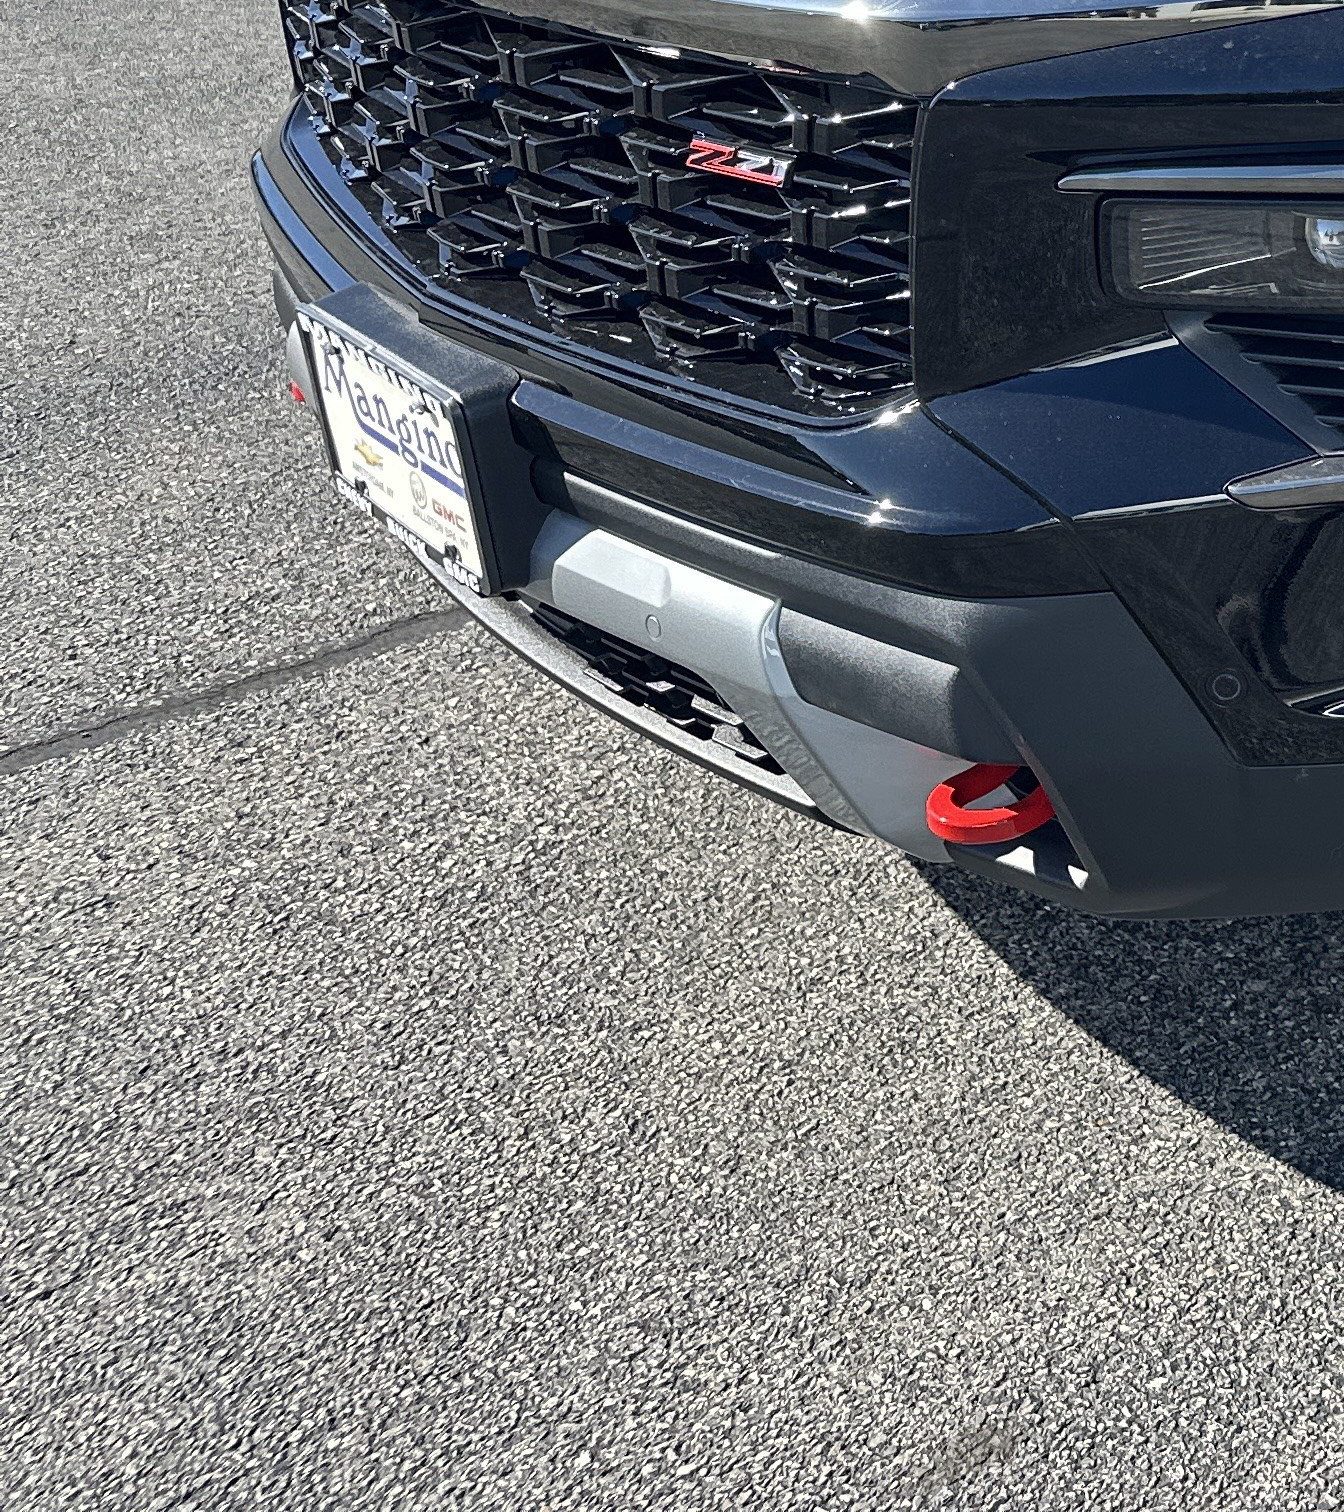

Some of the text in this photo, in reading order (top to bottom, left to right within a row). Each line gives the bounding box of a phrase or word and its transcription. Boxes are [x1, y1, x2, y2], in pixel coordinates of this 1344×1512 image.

[686, 138, 789, 188] Z71
[432, 498, 467, 533] GMC
[443, 557, 480, 593] GMC
